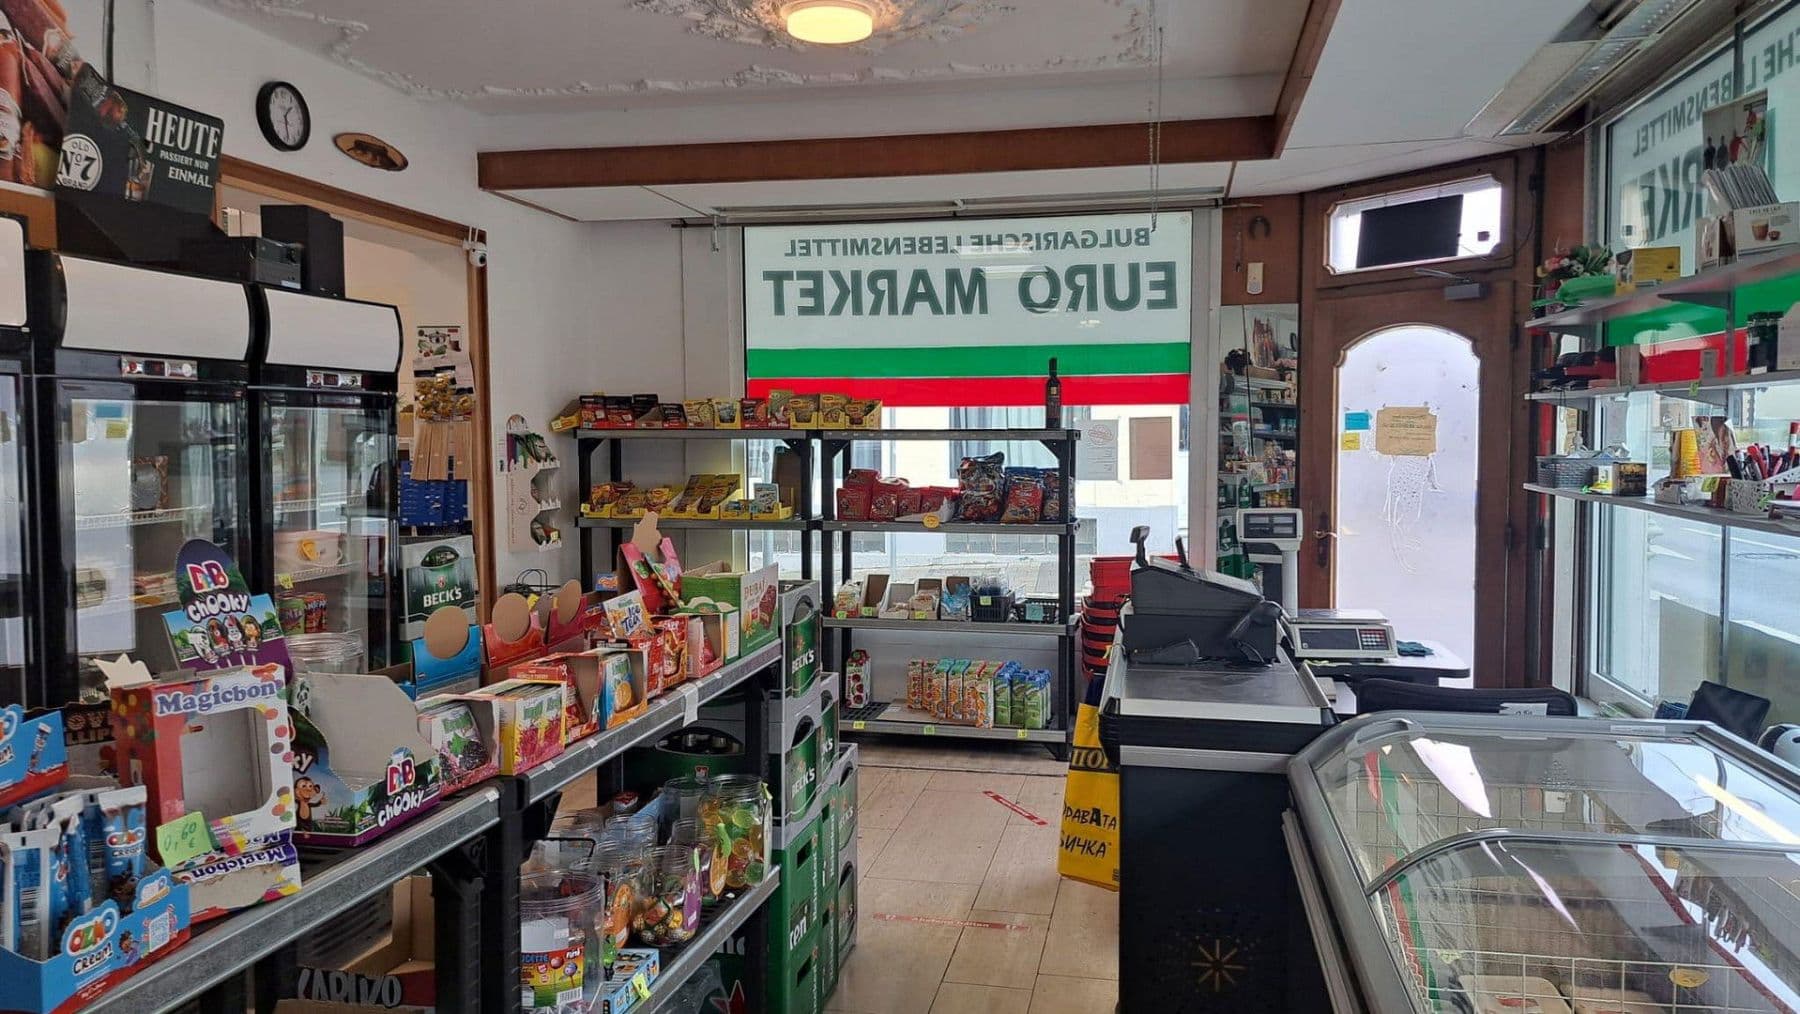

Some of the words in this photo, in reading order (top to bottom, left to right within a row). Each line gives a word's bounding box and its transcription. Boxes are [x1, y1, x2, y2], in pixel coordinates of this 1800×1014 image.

[71, 140, 90, 152] OLD
[146, 107, 221, 158] HEUTE
[160, 150, 193, 166] PASSIERT
[194, 158, 209, 170] NUR
[423, 585, 462, 608] BECK'S
[157, 682, 277, 715] Magicbon
[191, 846, 286, 879] Magicbon
